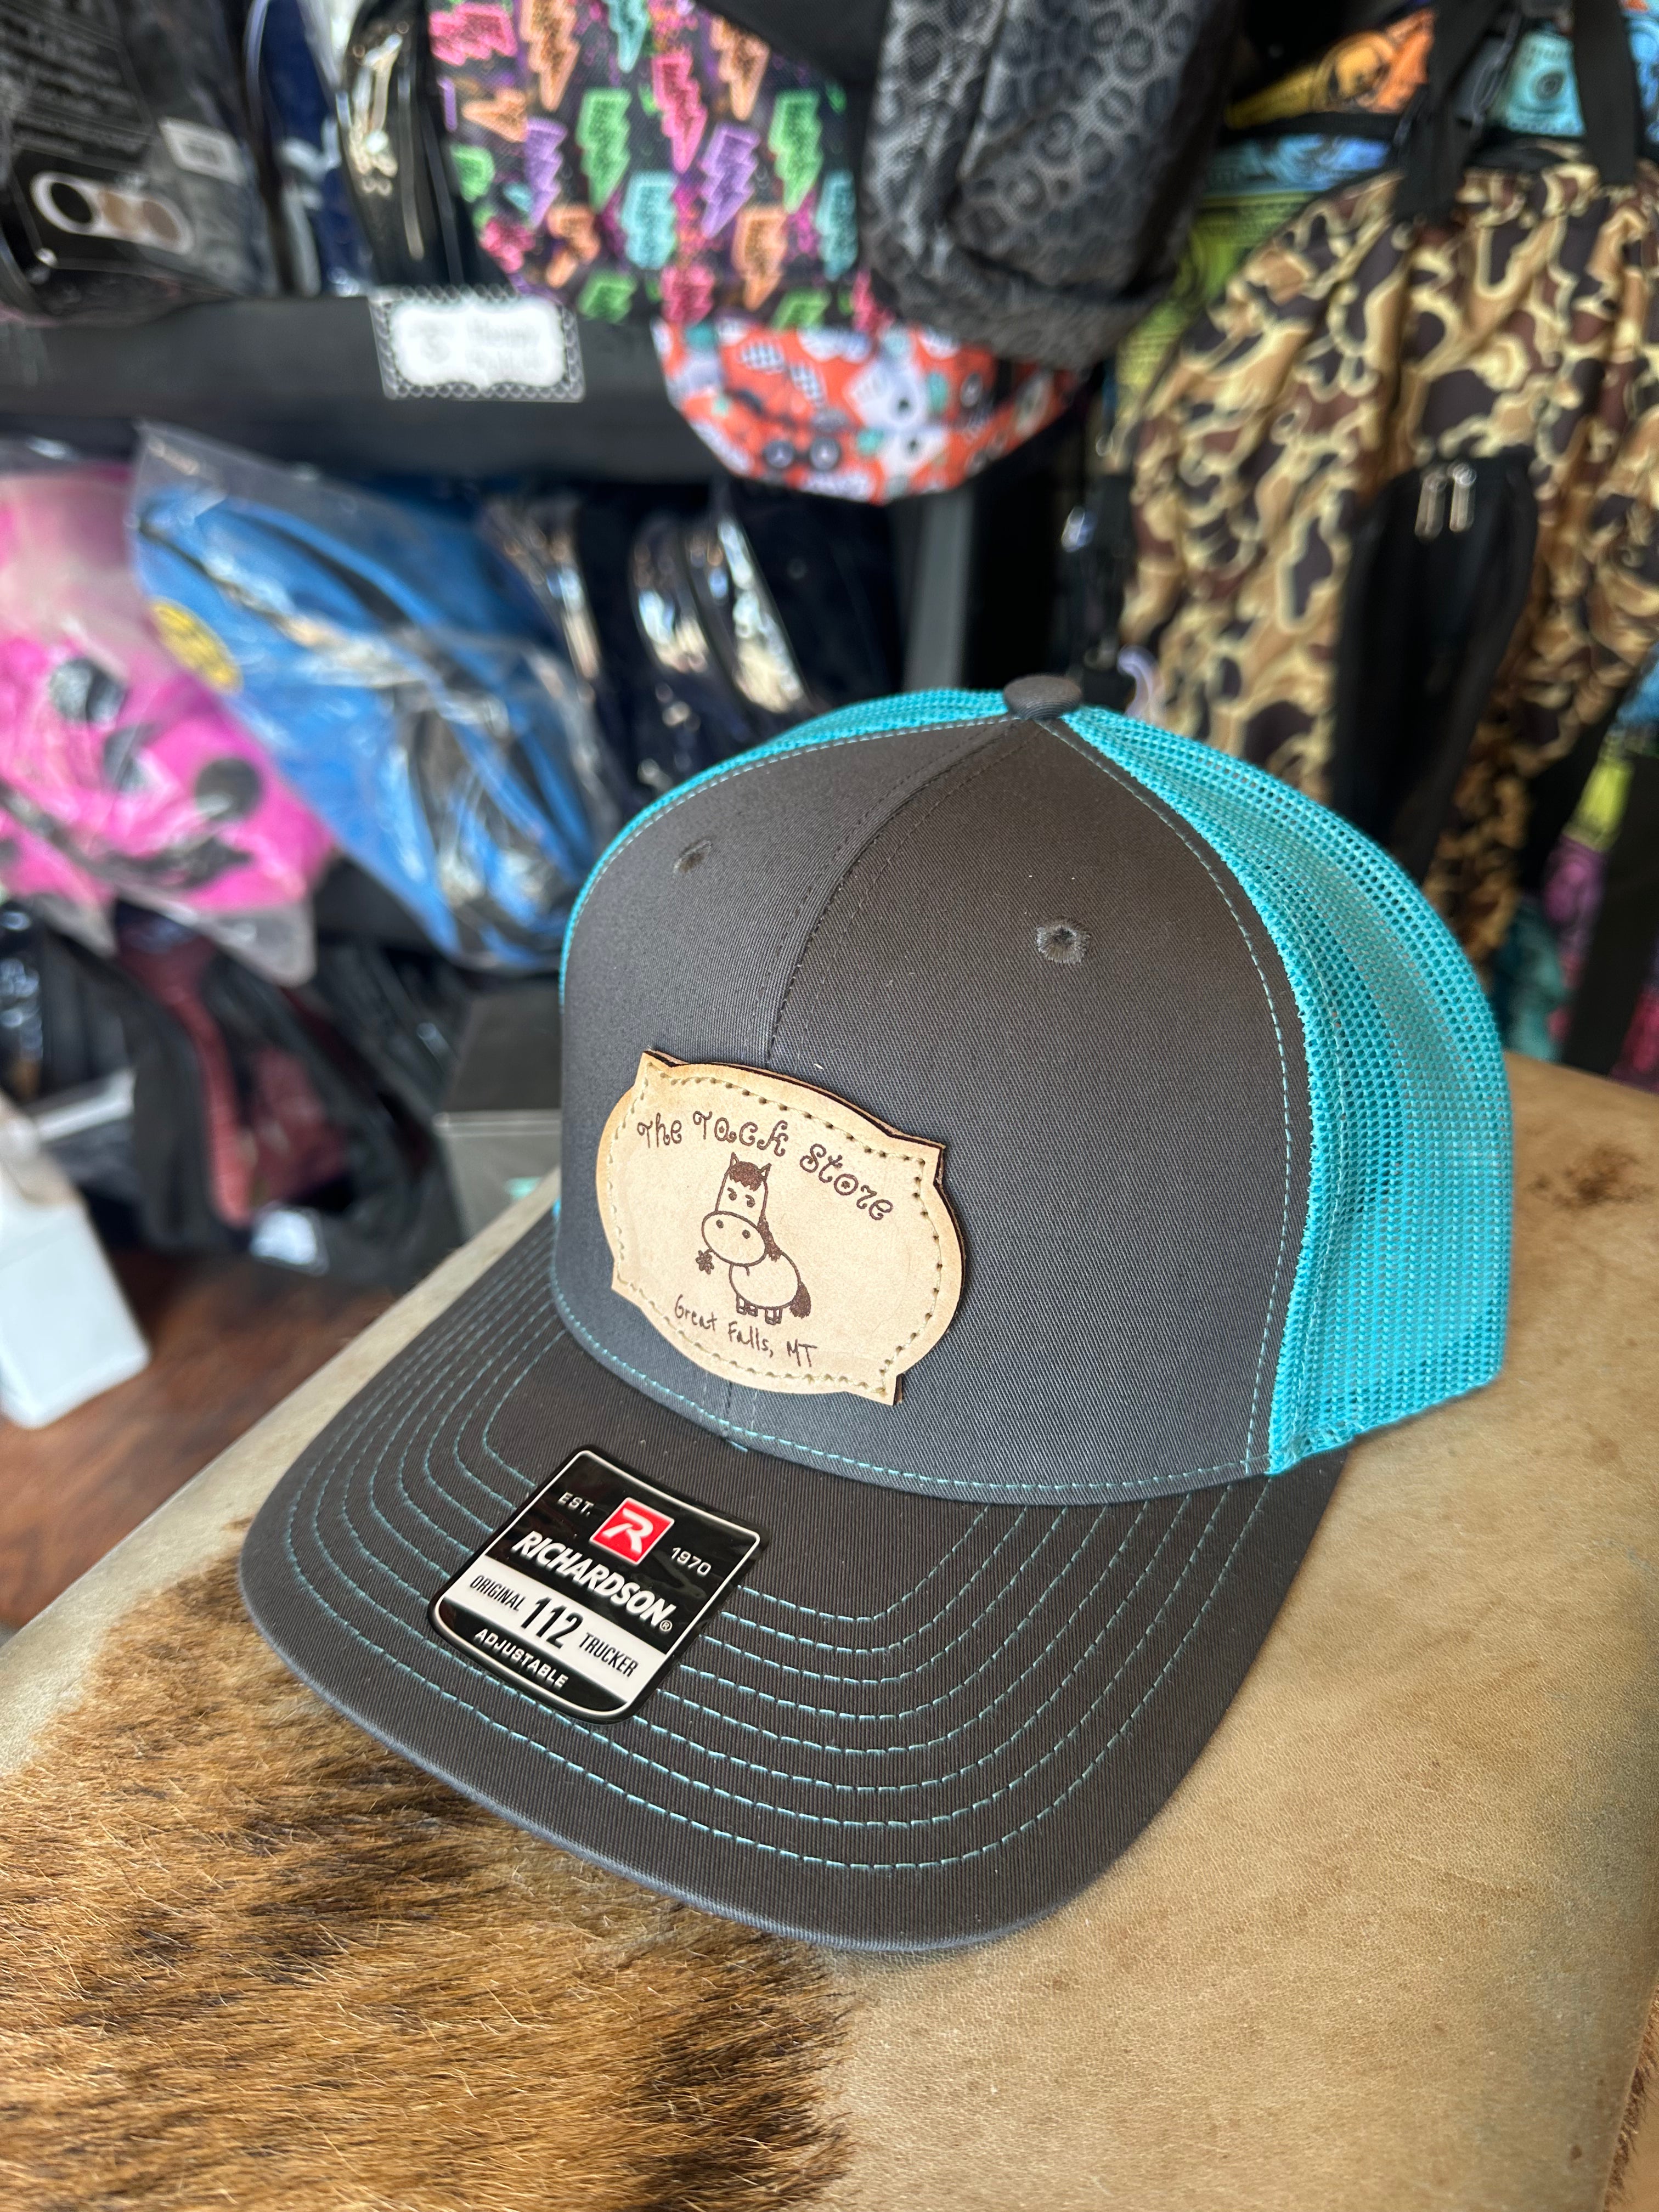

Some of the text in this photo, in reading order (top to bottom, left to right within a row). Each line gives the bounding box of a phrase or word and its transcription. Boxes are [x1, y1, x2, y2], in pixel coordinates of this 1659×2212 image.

[674, 1294, 818, 1368] Great Falls, MT
[557, 1492, 595, 1516] EST.
[601, 1507, 655, 1556] R
[671, 1546, 713, 1577] 1970
[469, 1574, 639, 1678] ORIGINAL 112 TRUCKER
[474, 1628, 569, 1689] ADJUSTABLE
